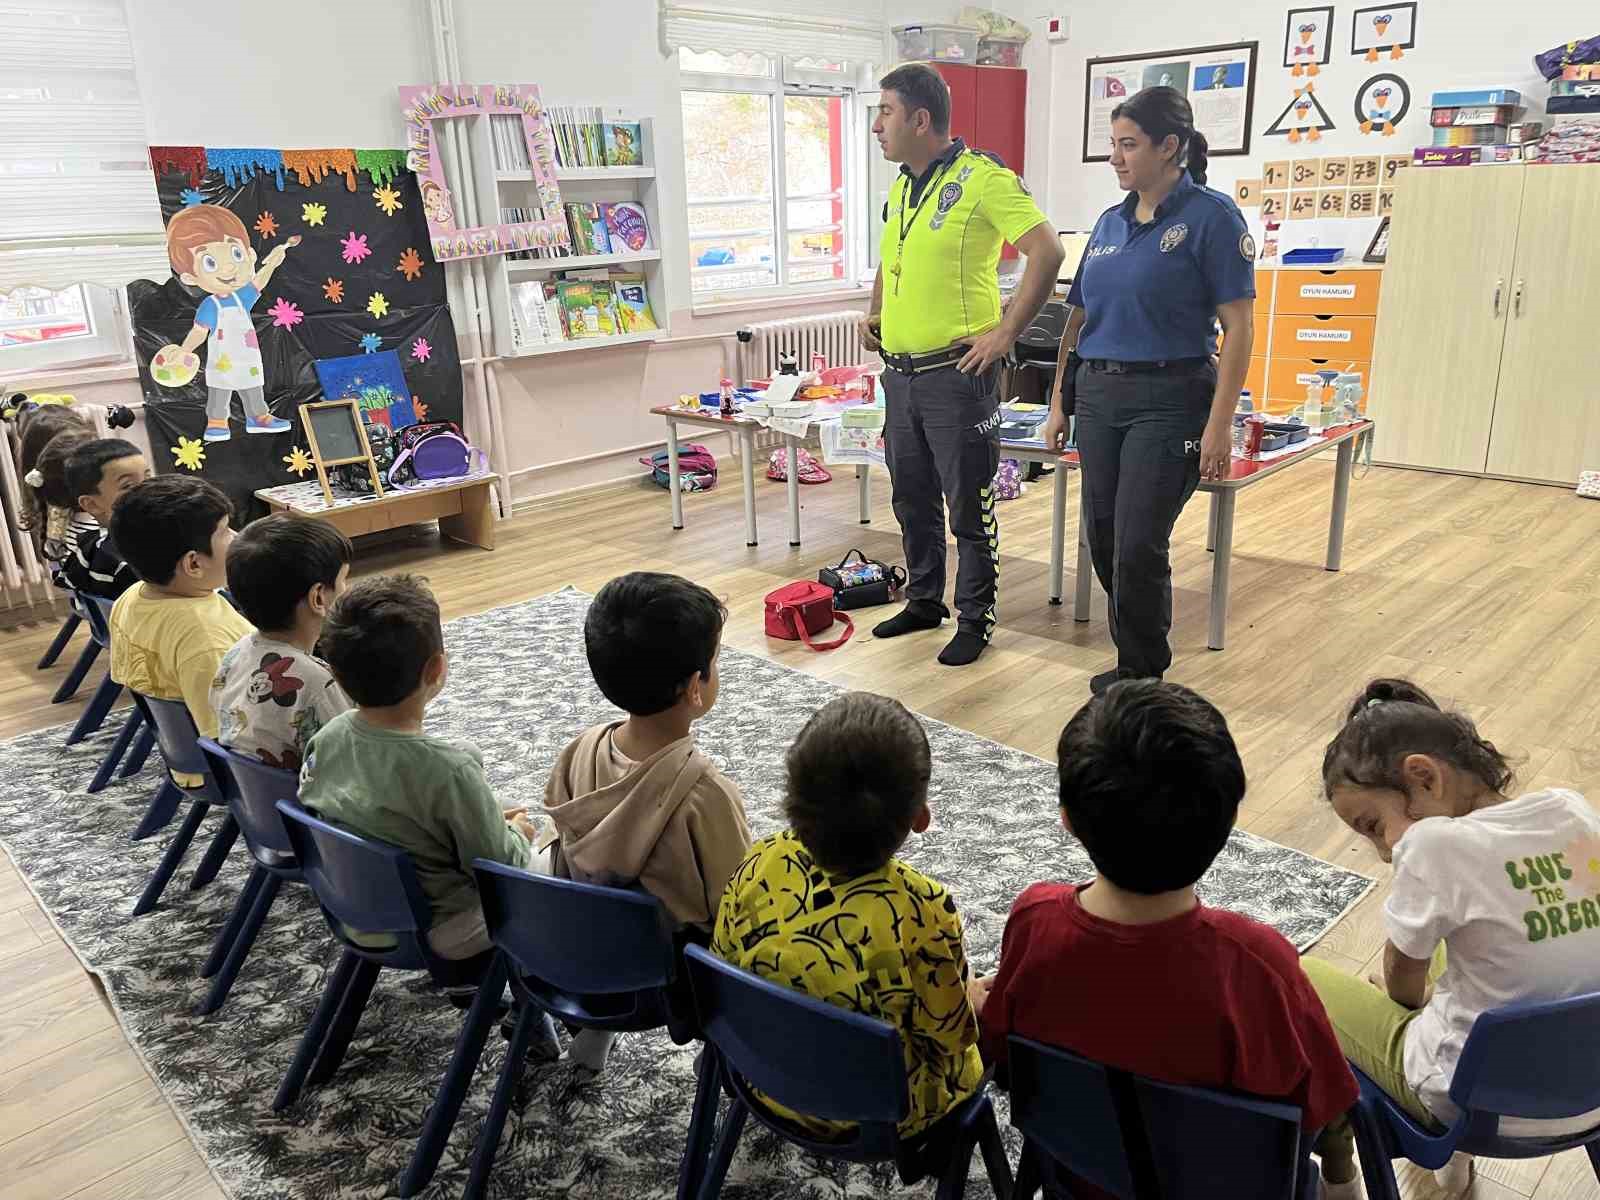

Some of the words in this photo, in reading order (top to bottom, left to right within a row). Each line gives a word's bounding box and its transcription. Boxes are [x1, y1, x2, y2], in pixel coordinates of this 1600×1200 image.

[1264, 167, 1274, 185] 1
[1294, 164, 1305, 183] 3
[1323, 162, 1337, 181] 5
[1353, 163, 1366, 180] 7
[1386, 159, 1398, 179] 9
[1239, 186, 1249, 200] 0
[1264, 198, 1274, 216] 2
[1292, 196, 1304, 213] 4
[1320, 193, 1332, 211] 6
[1350, 193, 1362, 212] 8
[1302, 287, 1322, 296] OYUN
[1184, 439, 1201, 454] PO
[1504, 851, 1573, 890] LIVE
[1531, 886, 1565, 905] The
[1523, 892, 1600, 942] DREA
